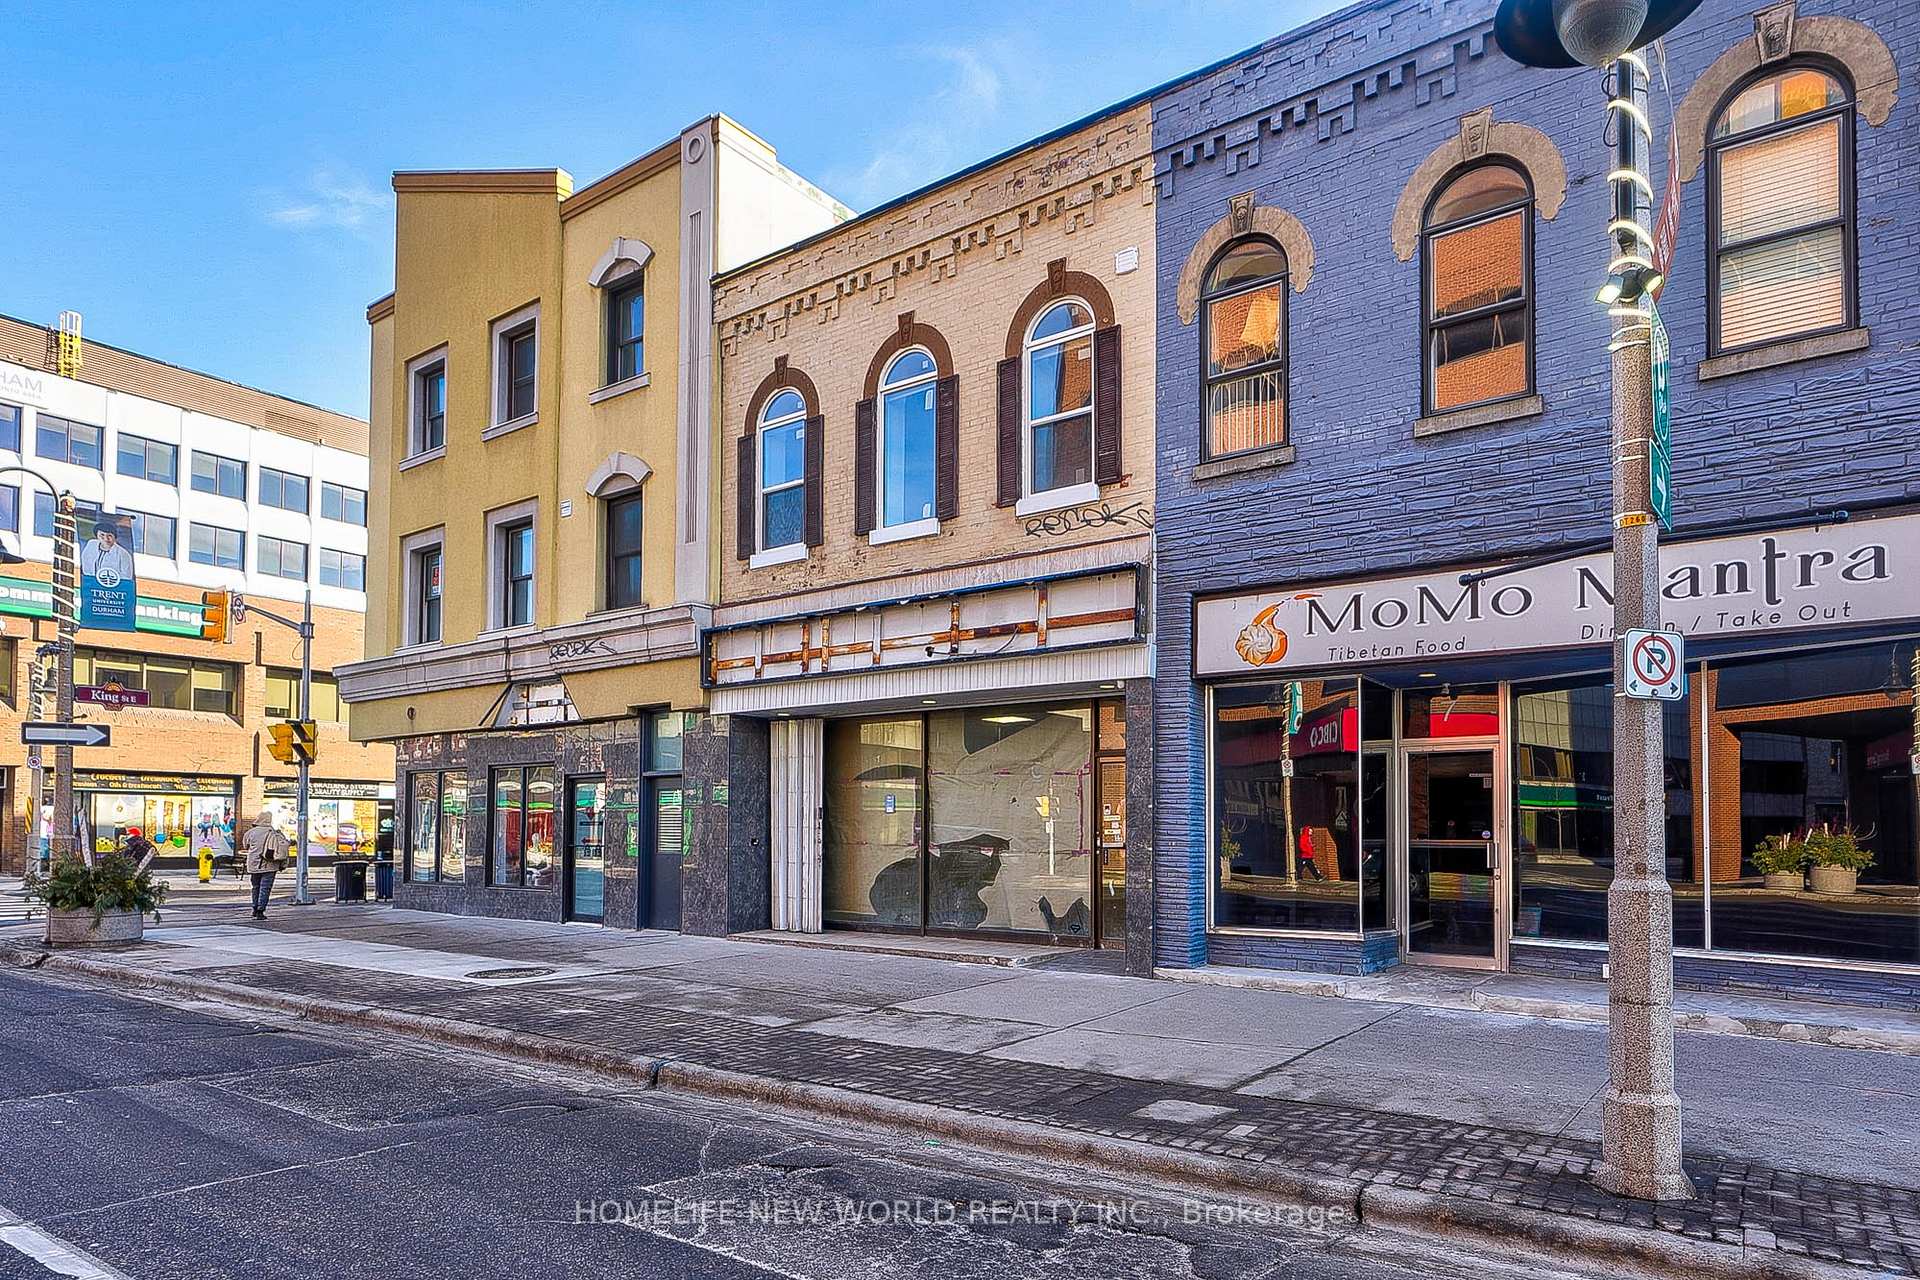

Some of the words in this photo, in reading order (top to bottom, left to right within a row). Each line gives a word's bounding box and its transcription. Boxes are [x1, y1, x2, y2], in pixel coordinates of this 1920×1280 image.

[91, 589, 127, 600] TRENT
[92, 606, 125, 615] DURHAM
[1304, 584, 1533, 636] MoMo
[1717, 610, 1782, 629] Take
[1799, 602, 1851, 621] Out
[1328, 644, 1404, 661] Tibetan
[1416, 636, 1465, 654] Food
[91, 690, 120, 703] King
[130, 695, 137, 703] E
